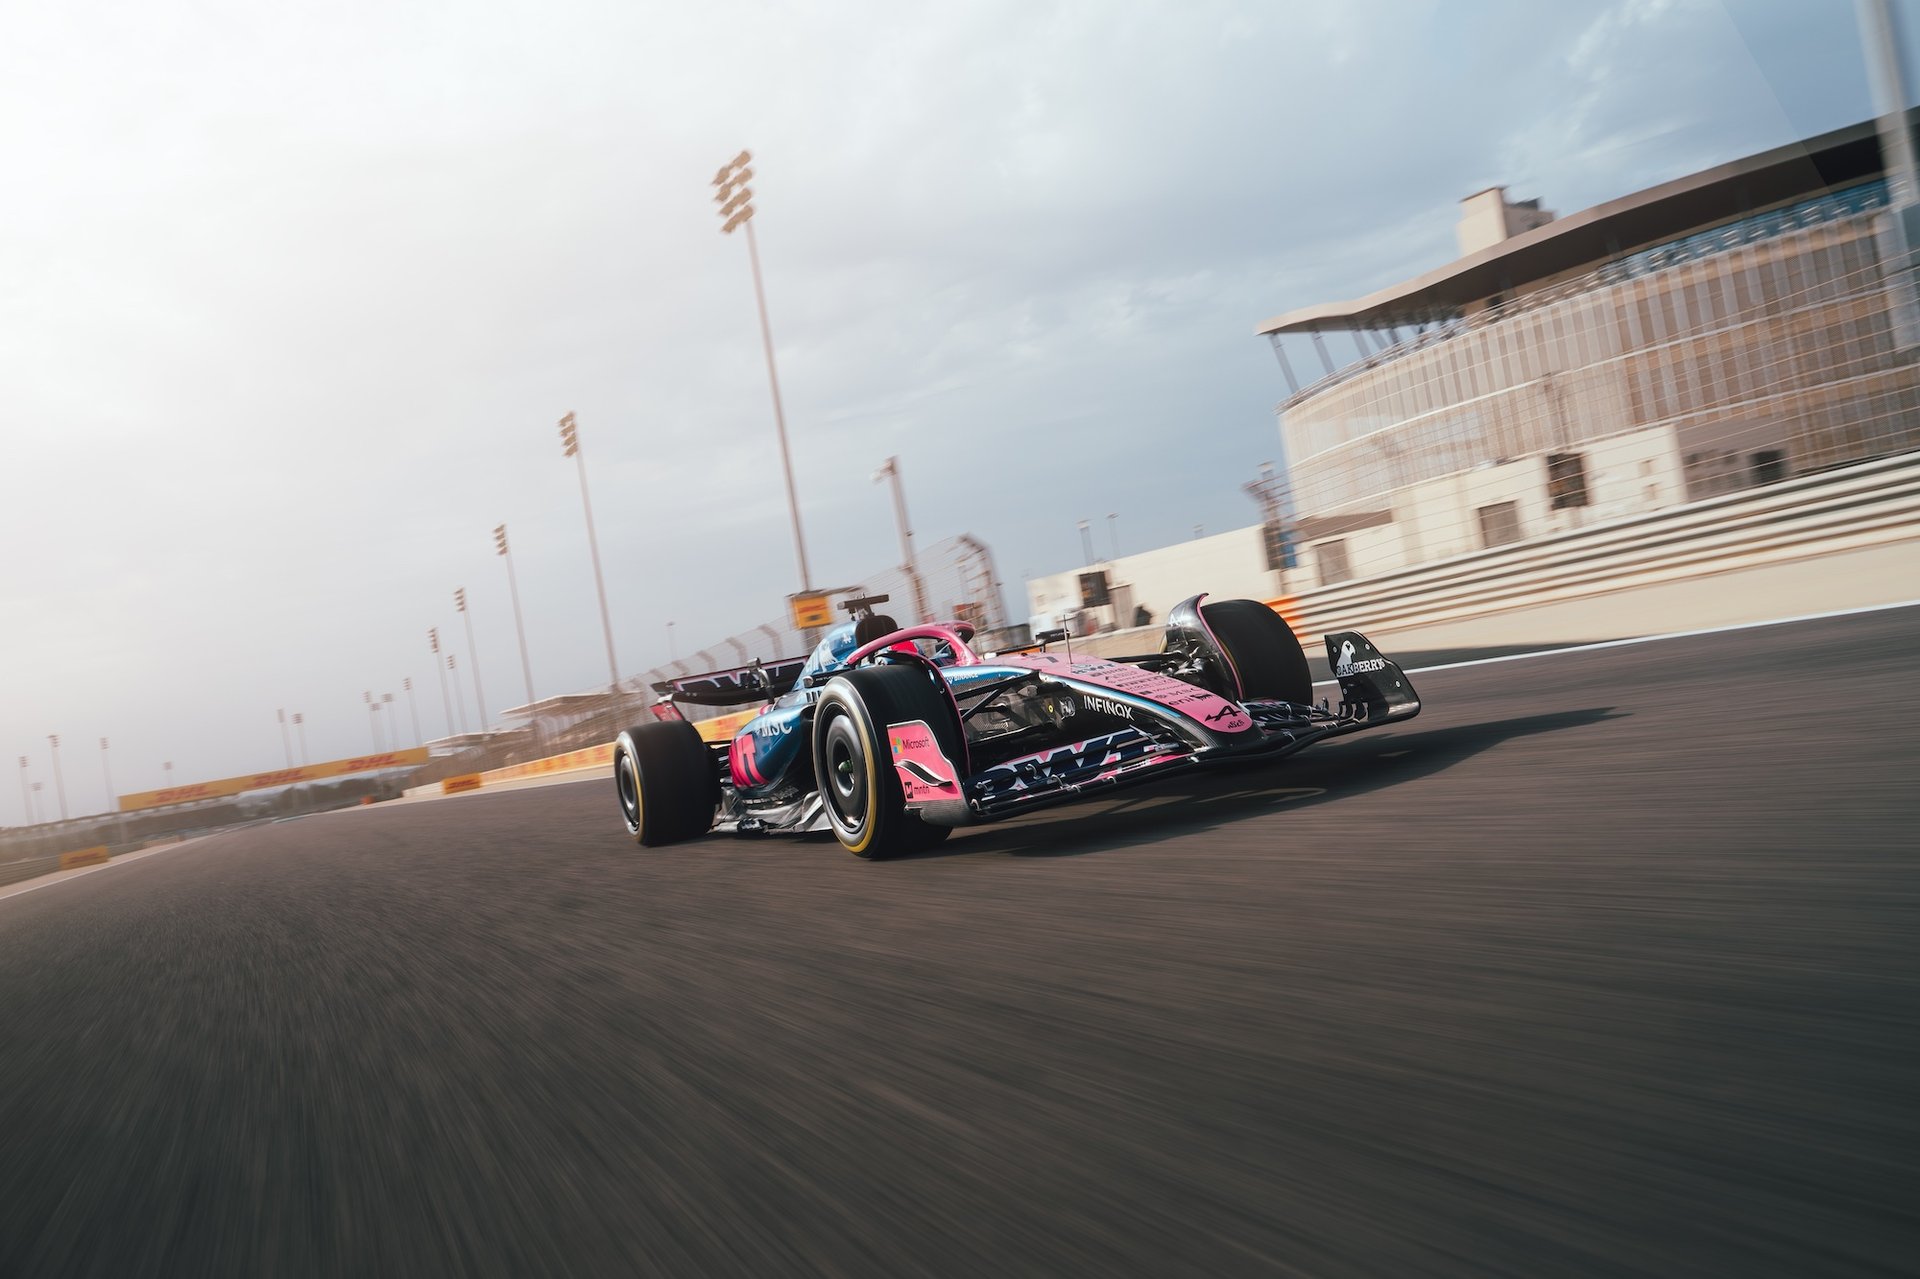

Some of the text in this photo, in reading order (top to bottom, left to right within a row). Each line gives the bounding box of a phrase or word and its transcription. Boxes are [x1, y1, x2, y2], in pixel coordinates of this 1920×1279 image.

[1336, 659, 1385, 677] OAKBERRY
[1083, 695, 1135, 720] INFINOX
[761, 718, 793, 738] MSC
[902, 736, 931, 750] Microsoft
